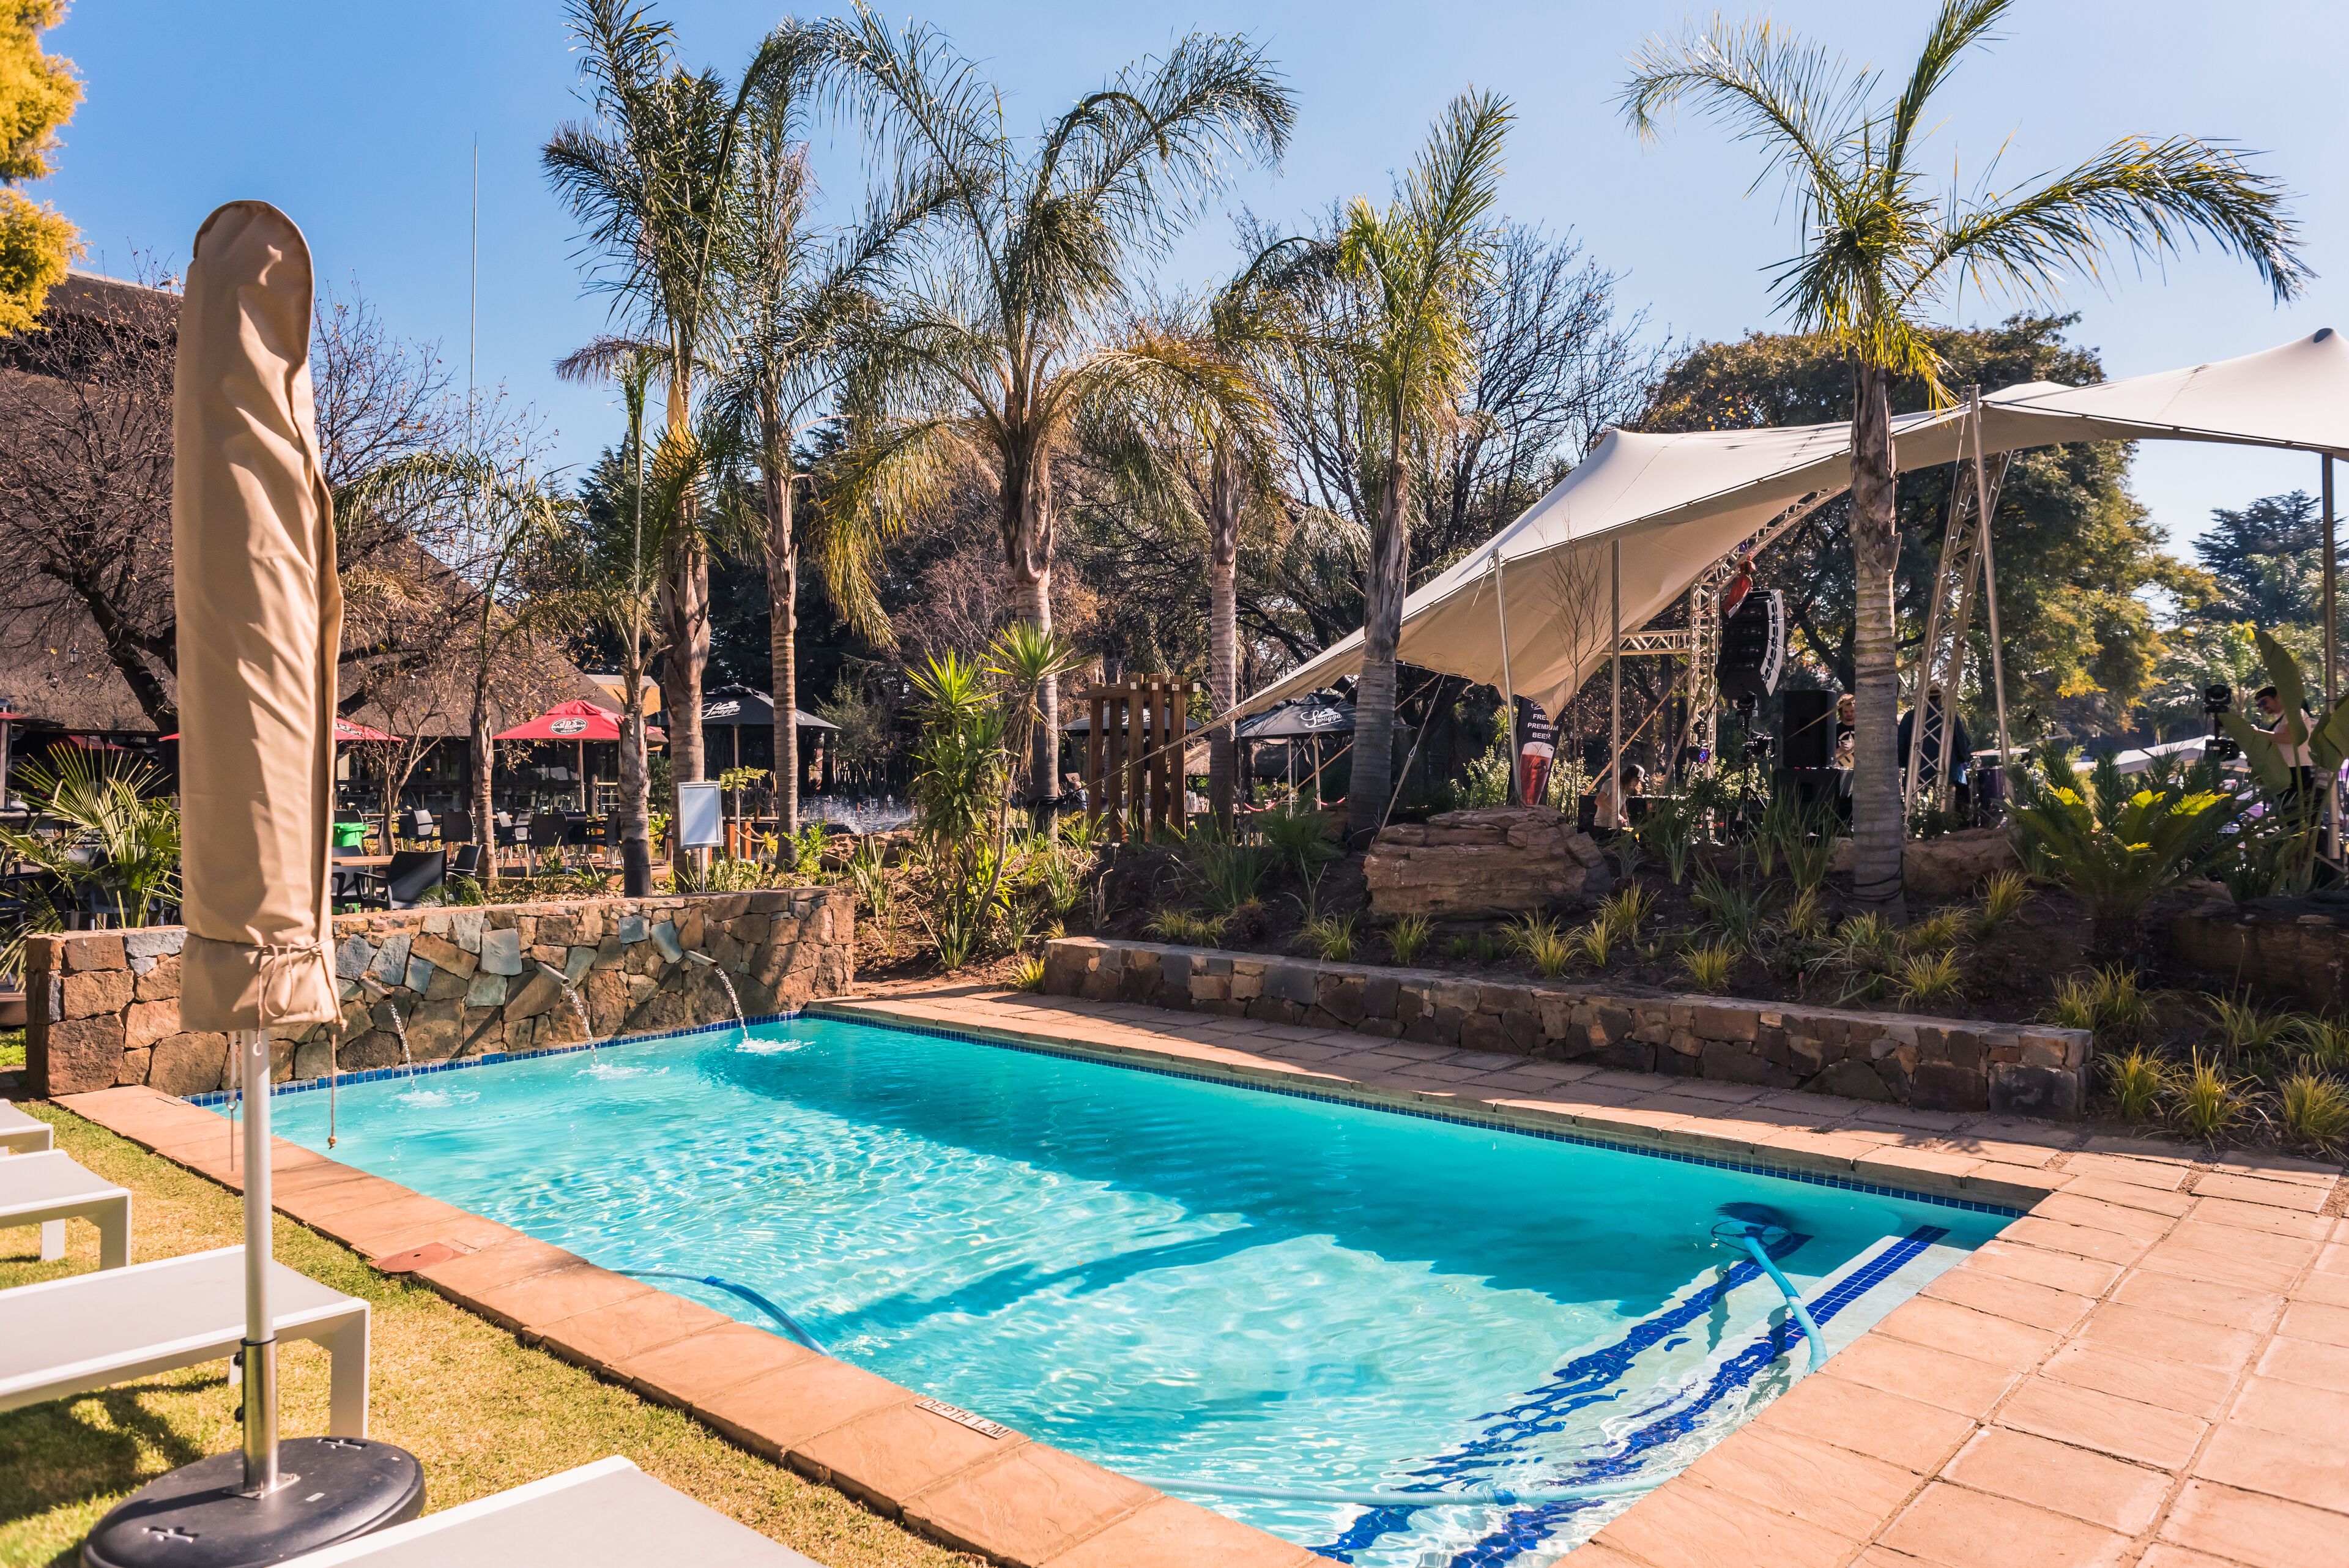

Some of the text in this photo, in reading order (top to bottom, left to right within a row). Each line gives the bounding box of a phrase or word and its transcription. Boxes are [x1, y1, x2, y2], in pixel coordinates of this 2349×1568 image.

[702, 702, 740, 718] Swagga
[1301, 710, 1342, 727] Swagga
[1527, 723, 1559, 731] PREMIUM
[920, 1399, 1010, 1436] DEPTH 1.2M
